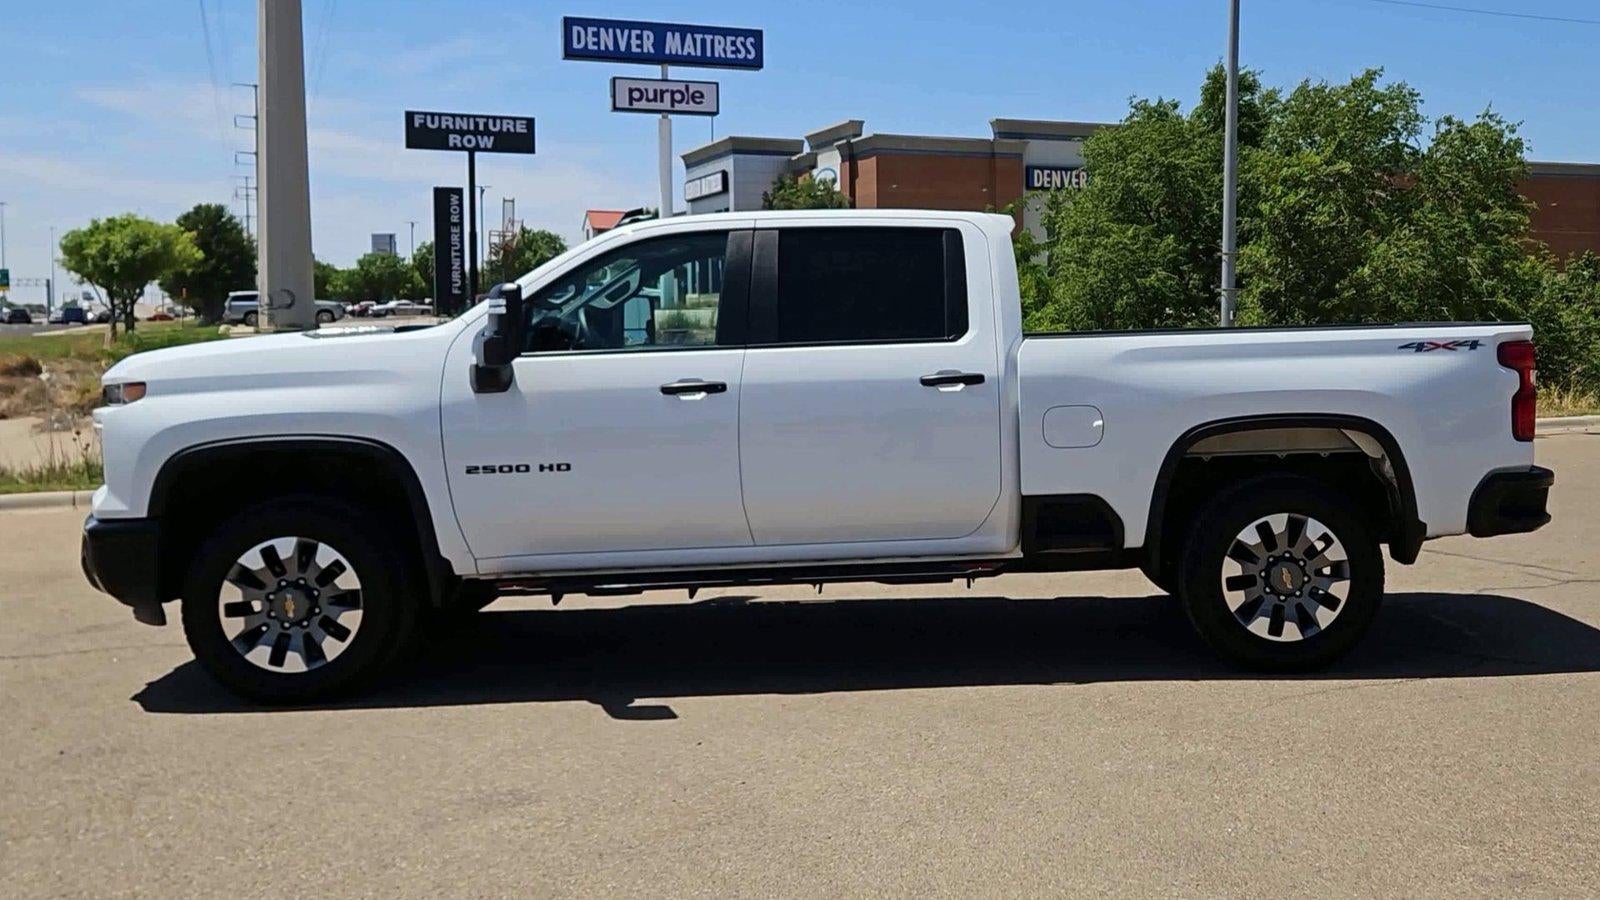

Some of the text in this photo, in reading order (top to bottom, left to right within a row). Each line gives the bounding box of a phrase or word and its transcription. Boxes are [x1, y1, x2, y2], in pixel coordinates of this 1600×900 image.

[572, 25, 756, 60] DENVER MATTRESS
[628, 84, 705, 108] purple
[413, 114, 528, 133] FURNITURE
[448, 133, 495, 149] ROW
[1033, 169, 1088, 189] DENVER
[450, 193, 462, 294] FURNITURE ROW
[465, 463, 572, 474] 2500 HD
